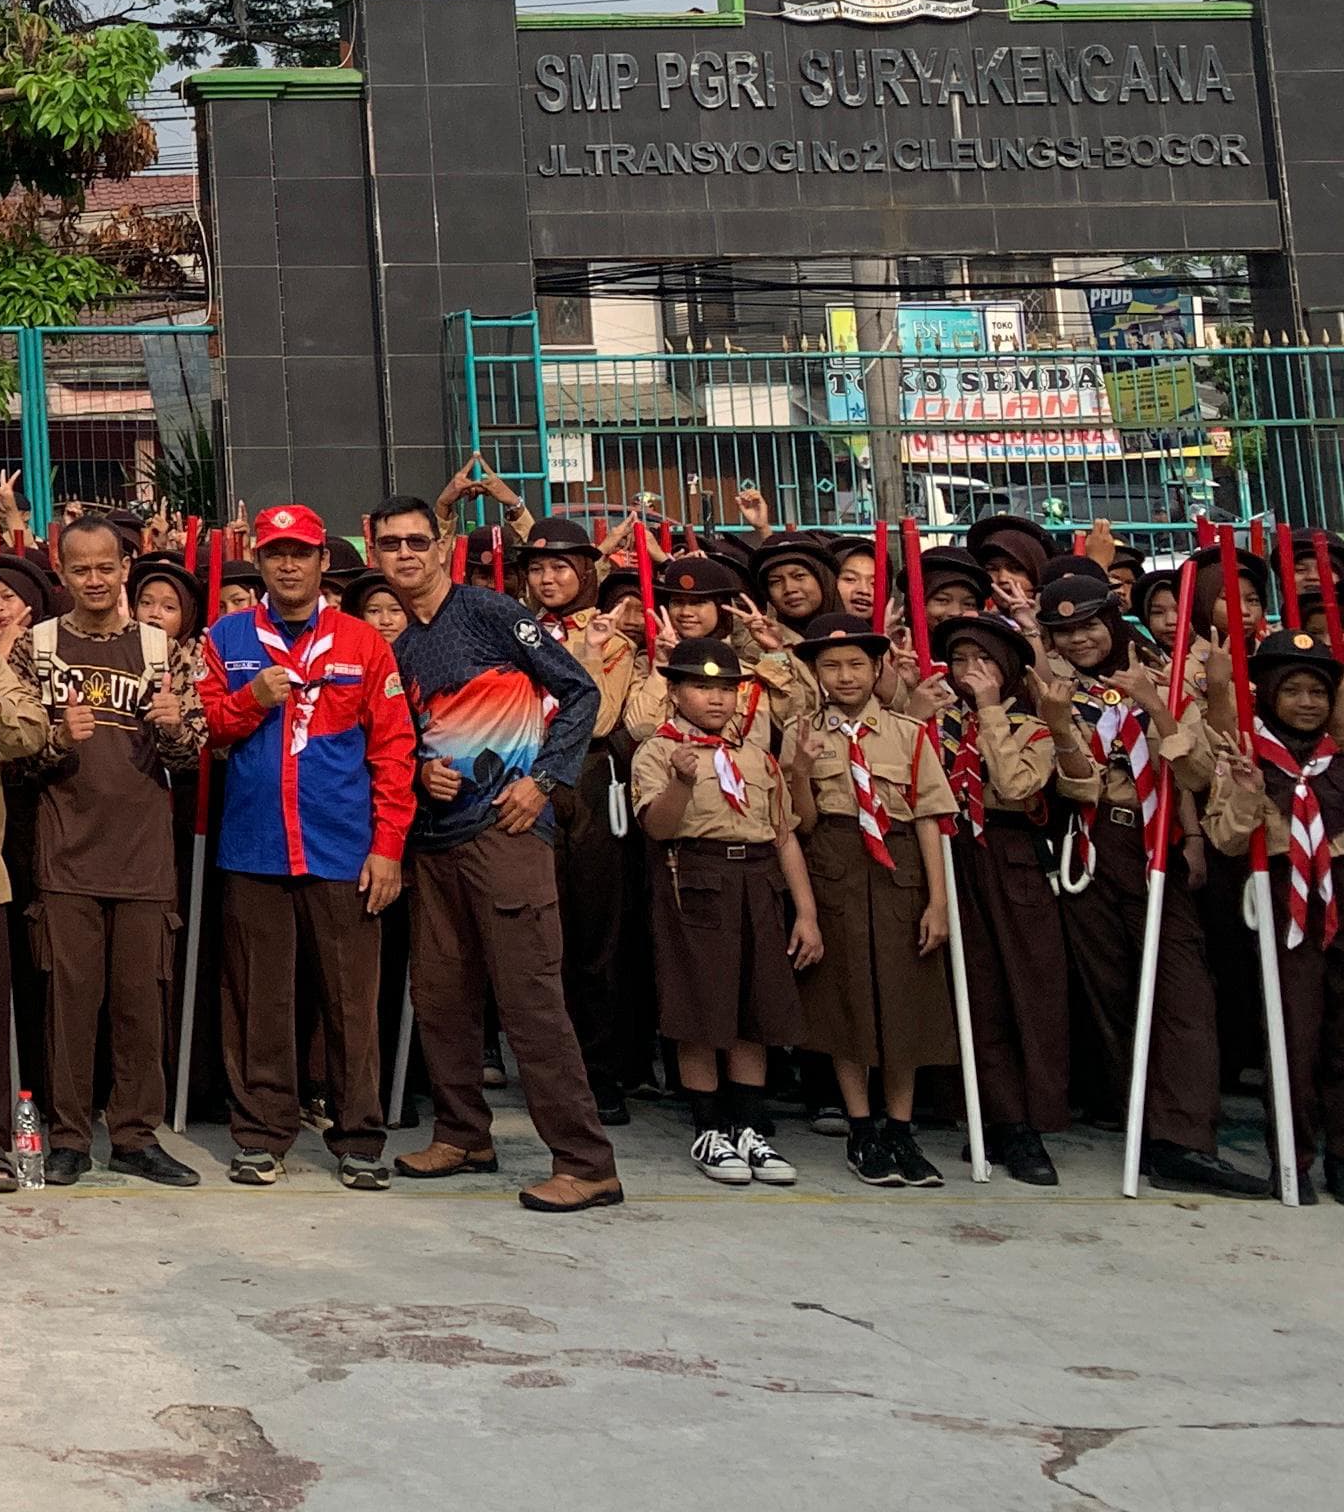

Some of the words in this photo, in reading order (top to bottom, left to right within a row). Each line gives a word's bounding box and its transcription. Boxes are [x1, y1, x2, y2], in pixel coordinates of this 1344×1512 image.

[886, 2, 924, 18] LEMBAGA
[535, 52, 640, 112] SMP
[655, 50, 777, 109] PGRI
[799, 44, 1236, 107] SURYAKENCANA
[1090, 288, 1133, 308] PPDB
[912, 319, 948, 338] ESSE
[991, 321, 1014, 329] TOKO
[958, 364, 1106, 395] SEMBA
[913, 394, 1079, 418] DILAN
